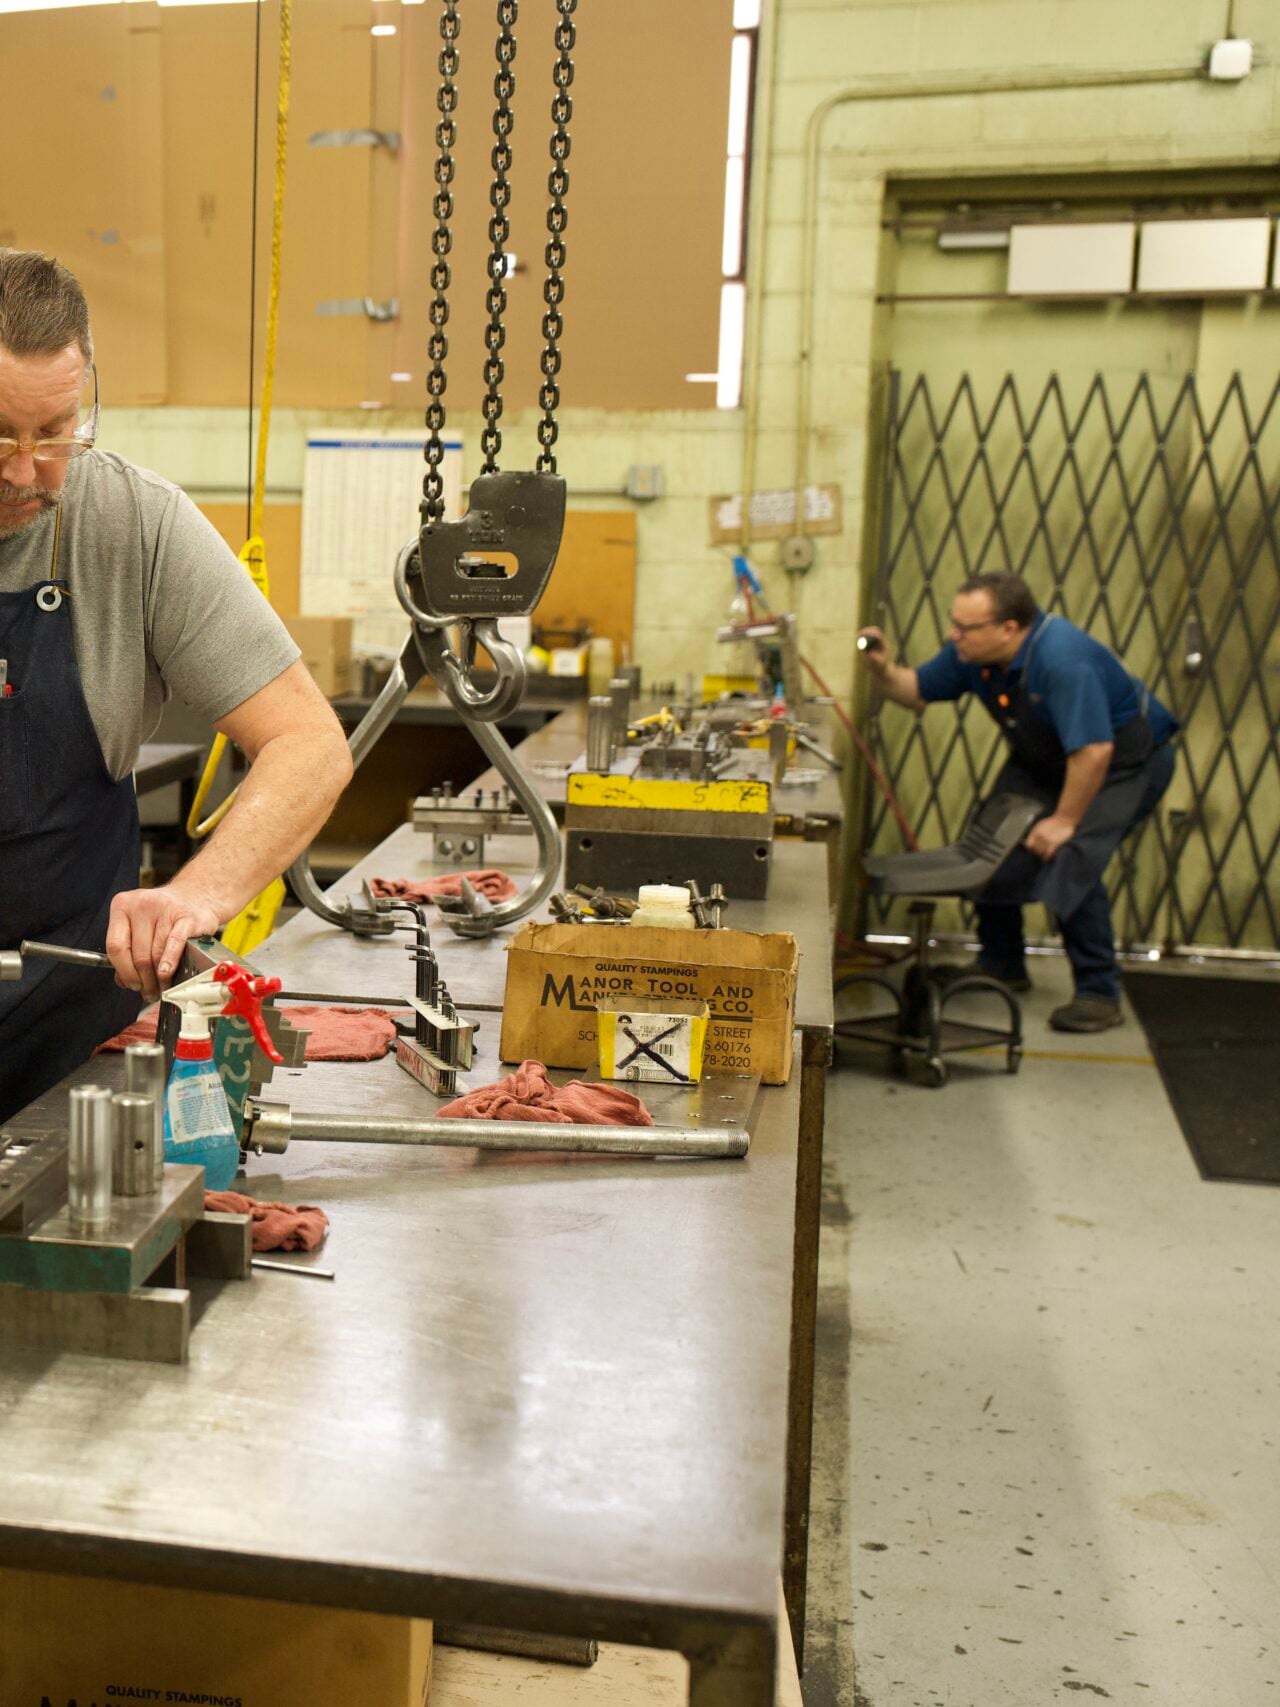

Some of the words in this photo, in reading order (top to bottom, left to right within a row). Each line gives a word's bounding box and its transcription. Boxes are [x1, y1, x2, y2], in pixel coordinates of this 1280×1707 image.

[595, 963, 637, 974] QUALITY
[639, 965, 698, 978] STAMPINGS
[647, 979, 698, 996] TOOL
[712, 984, 754, 999] AND
[722, 1000, 754, 1014] CO.
[713, 1025, 753, 1039] STREET
[714, 1042, 751, 1054] 60176
[702, 1055, 751, 1069] 78-2020
[104, 1684, 161, 1699] QUALITY
[165, 1691, 242, 1707] STAMPINGS
